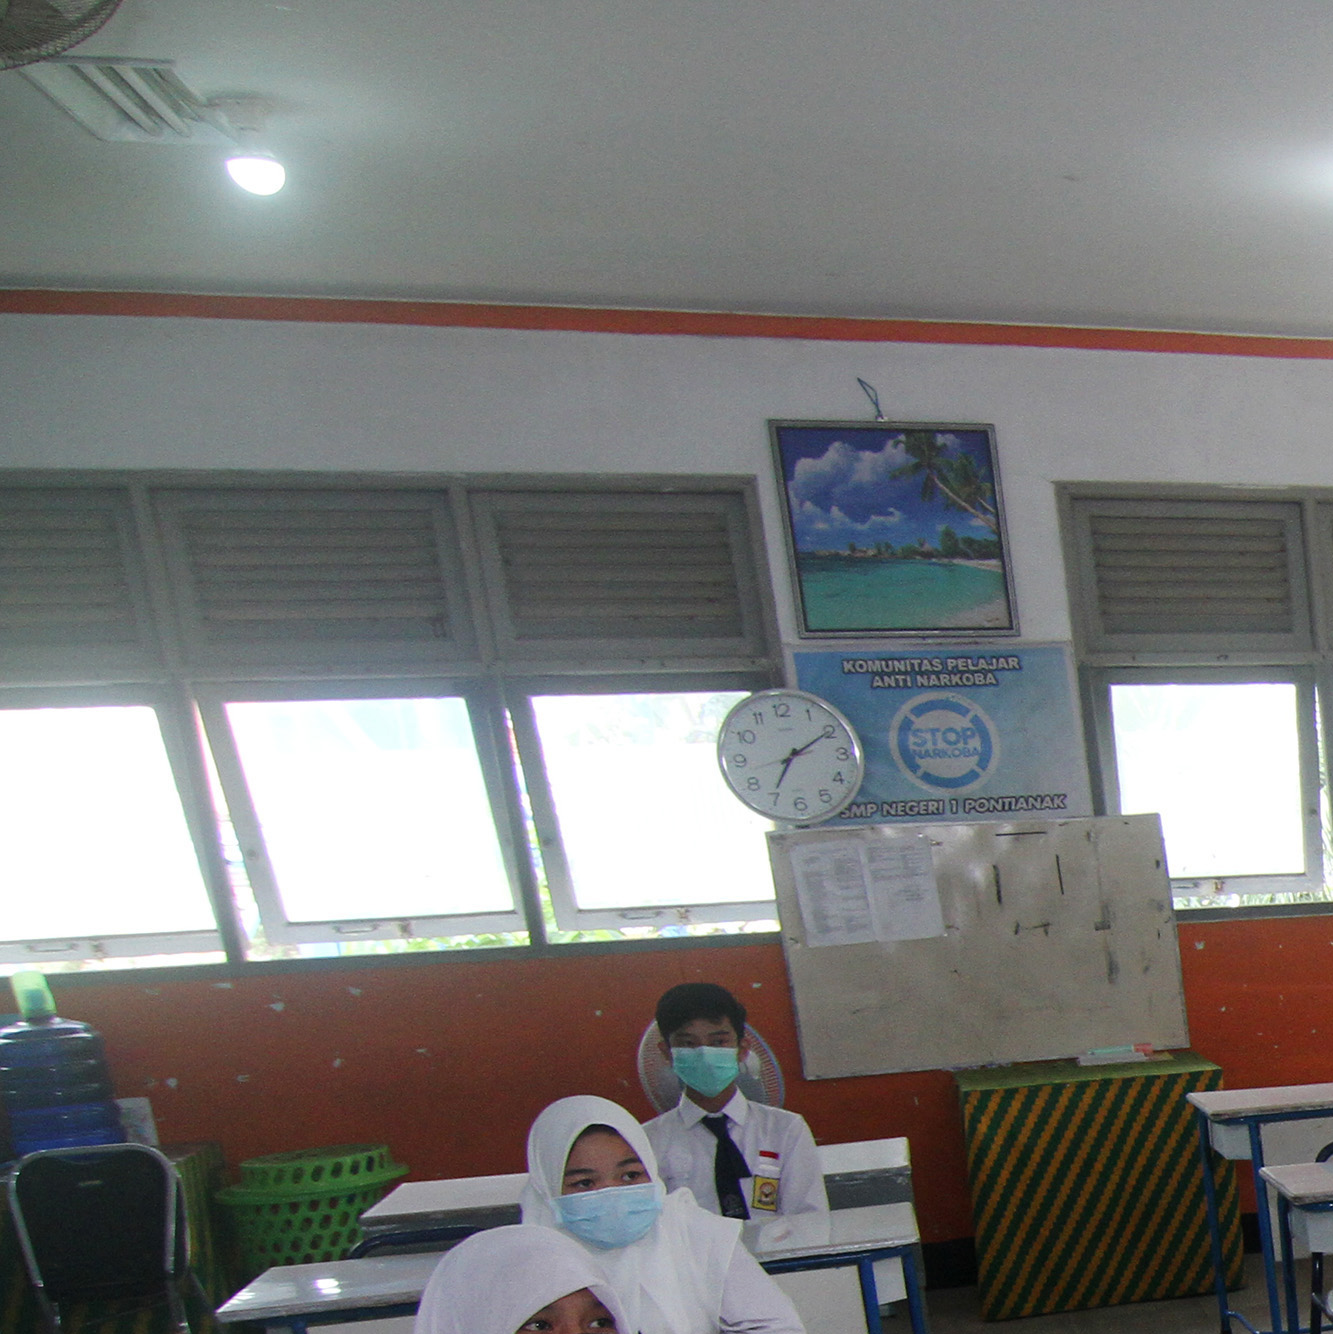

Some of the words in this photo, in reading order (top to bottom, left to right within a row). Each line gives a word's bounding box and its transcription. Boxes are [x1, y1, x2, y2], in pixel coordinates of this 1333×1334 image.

[842, 658, 943, 674] KOMUNITAS
[947, 656, 1020, 671] PELAJAR
[872, 675, 912, 688] ANTI
[916, 673, 997, 687] NARKOBA
[772, 703, 791, 718] 12
[805, 708, 812, 721] 1
[752, 712, 764, 725] 11
[736, 729, 756, 744] 10
[822, 724, 837, 739] 2
[912, 727, 976, 746] STOP
[733, 753, 747, 768] 9
[835, 746, 849, 761] 3
[913, 746, 981, 760] NARKOBA
[747, 776, 760, 791] 8
[832, 771, 845, 785] 4
[768, 792, 780, 806] 7
[794, 796, 808, 811] 6
[818, 789, 832, 804] 5
[840, 802, 879, 819] SMP
[883, 800, 944, 817] NEGERI
[950, 799, 959, 814] 1
[964, 795, 1067, 814] PONTIANAK
